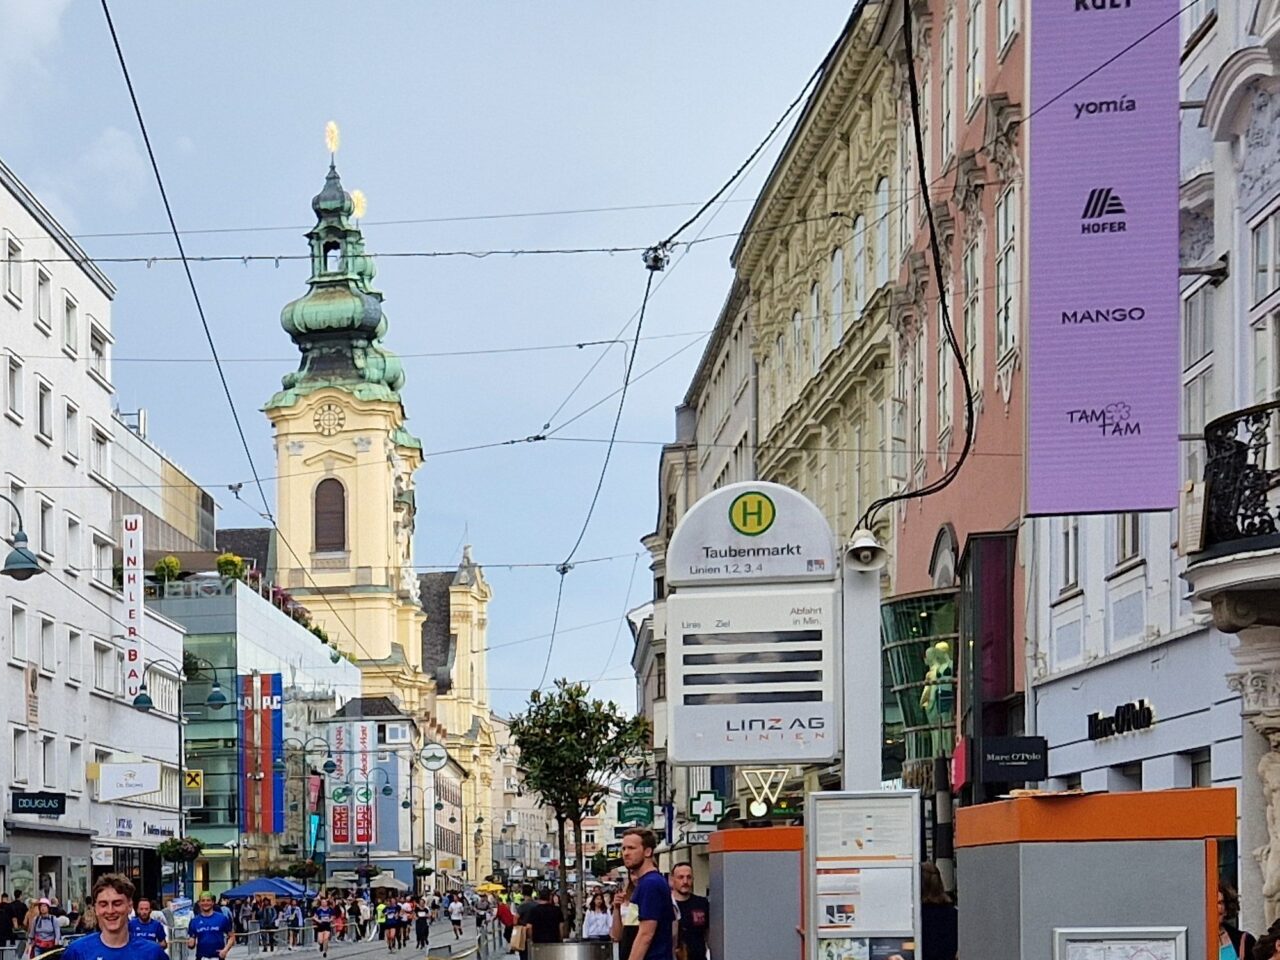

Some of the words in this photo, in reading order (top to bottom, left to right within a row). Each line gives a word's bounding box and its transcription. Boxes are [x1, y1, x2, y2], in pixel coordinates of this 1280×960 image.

[1074, 94, 1136, 119] yomía
[1081, 221, 1127, 234] HOFER
[1061, 307, 1145, 325] MANGO
[1066, 409, 1107, 424] TAM
[1098, 422, 1142, 436] TAM
[702, 544, 802, 559] Taubenmarkt
[689, 566, 720, 574] Linien
[790, 607, 822, 615] Abfahrt
[716, 620, 730, 628] Ziel
[128, 649, 139, 696] BAU
[727, 719, 782, 731] LINZ
[789, 717, 825, 729] AG
[727, 732, 825, 741] LINIEN
[986, 753, 1010, 761] Marc
[19, 798, 59, 808] DOUGLAS
